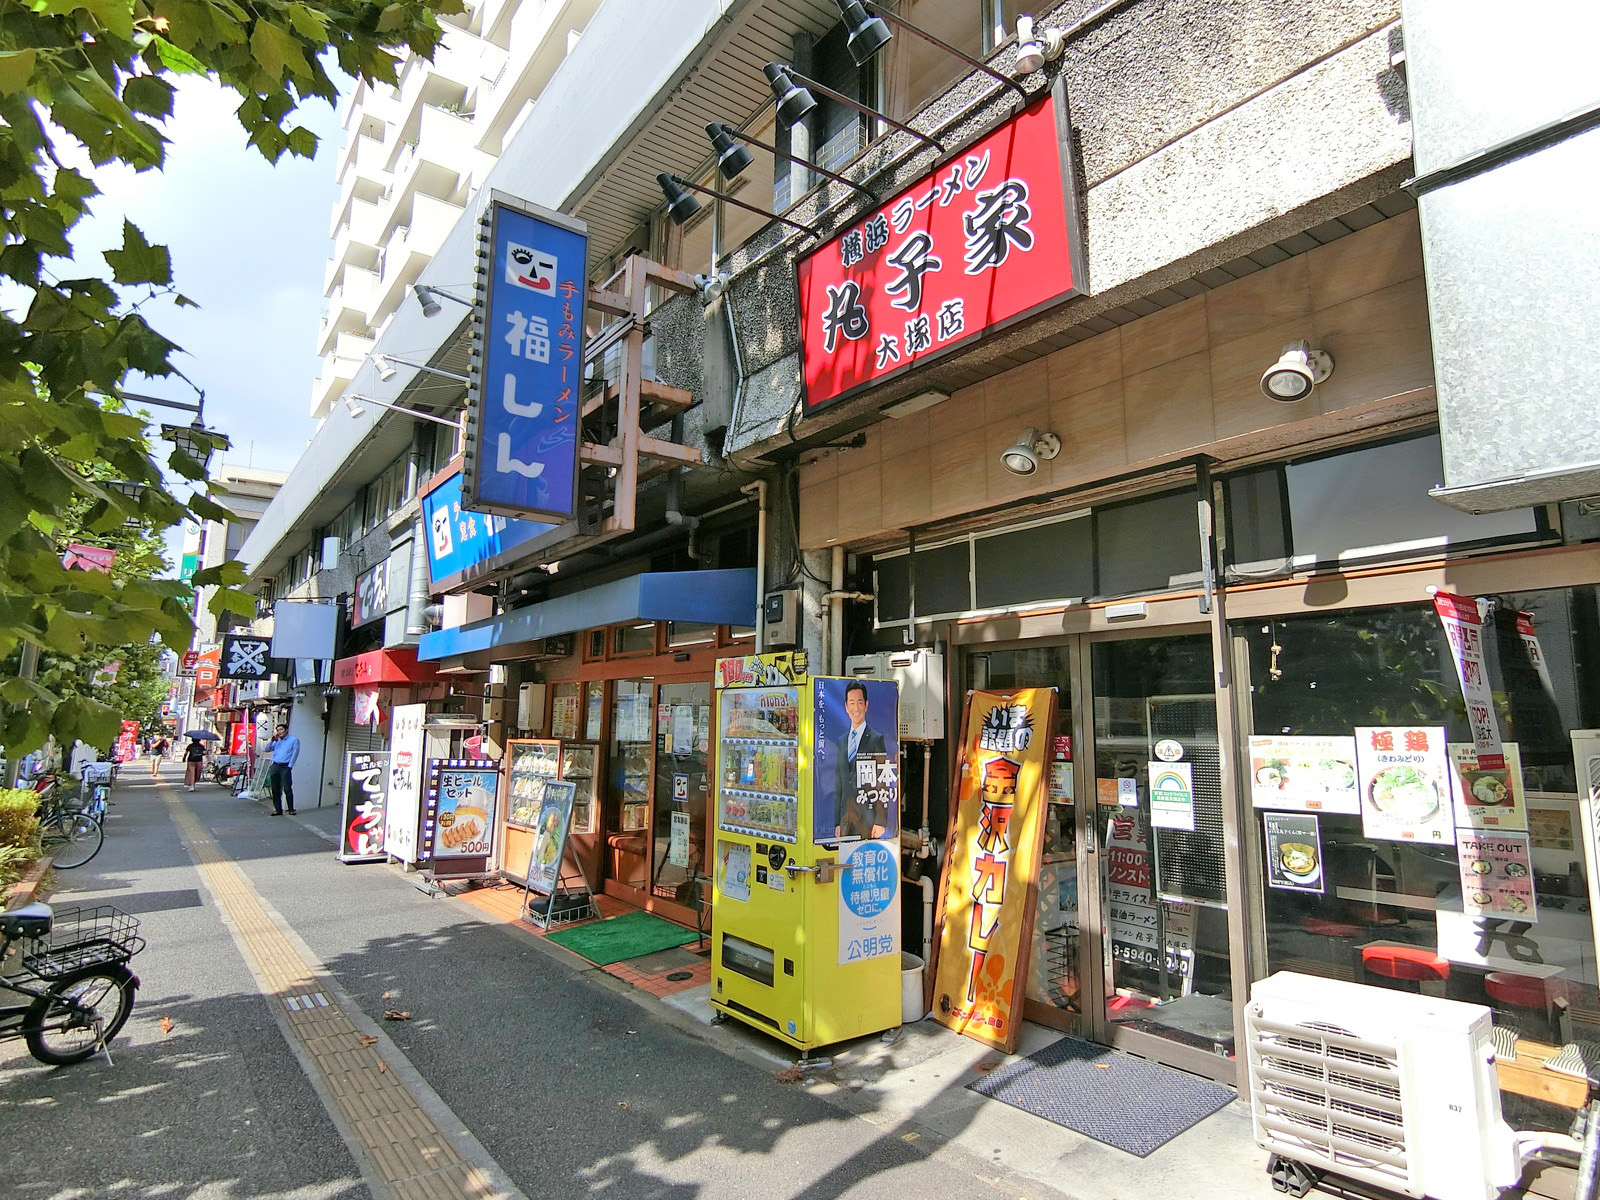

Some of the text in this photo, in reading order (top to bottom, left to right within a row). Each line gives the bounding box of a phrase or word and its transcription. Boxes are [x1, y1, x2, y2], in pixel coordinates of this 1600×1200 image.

[841, 149, 991, 267] 横浜ラーメン
[822, 178, 1034, 353] 丸子家
[876, 298, 965, 369] 大塚店
[553, 280, 579, 424] 手もみラーメン
[496, 310, 550, 479] 福しん
[760, 694, 789, 707] Aloha!
[817, 681, 825, 760] 日本を、もっと前へ。
[990, 705, 1027, 729] いま
[979, 725, 1034, 752] 話題の
[443, 775, 482, 787] 生ビール
[856, 759, 897, 788] 岡本
[446, 787, 473, 798] セット
[856, 788, 897, 805] みつなり
[352, 769, 385, 855] てっちゃん
[1432, 830, 1442, 839] 円
[460, 841, 490, 854] 500円
[1462, 841, 1522, 853] TAKE OUT
[852, 849, 889, 868] 教育の
[852, 865, 889, 885] 無償化
[966, 757, 1021, 1003] 金沢カレー
[1109, 867, 1151, 885] ノンスト
[850, 887, 890, 905] 待機児童
[857, 903, 883, 915] ゼロに。
[847, 933, 893, 961] 公明党
